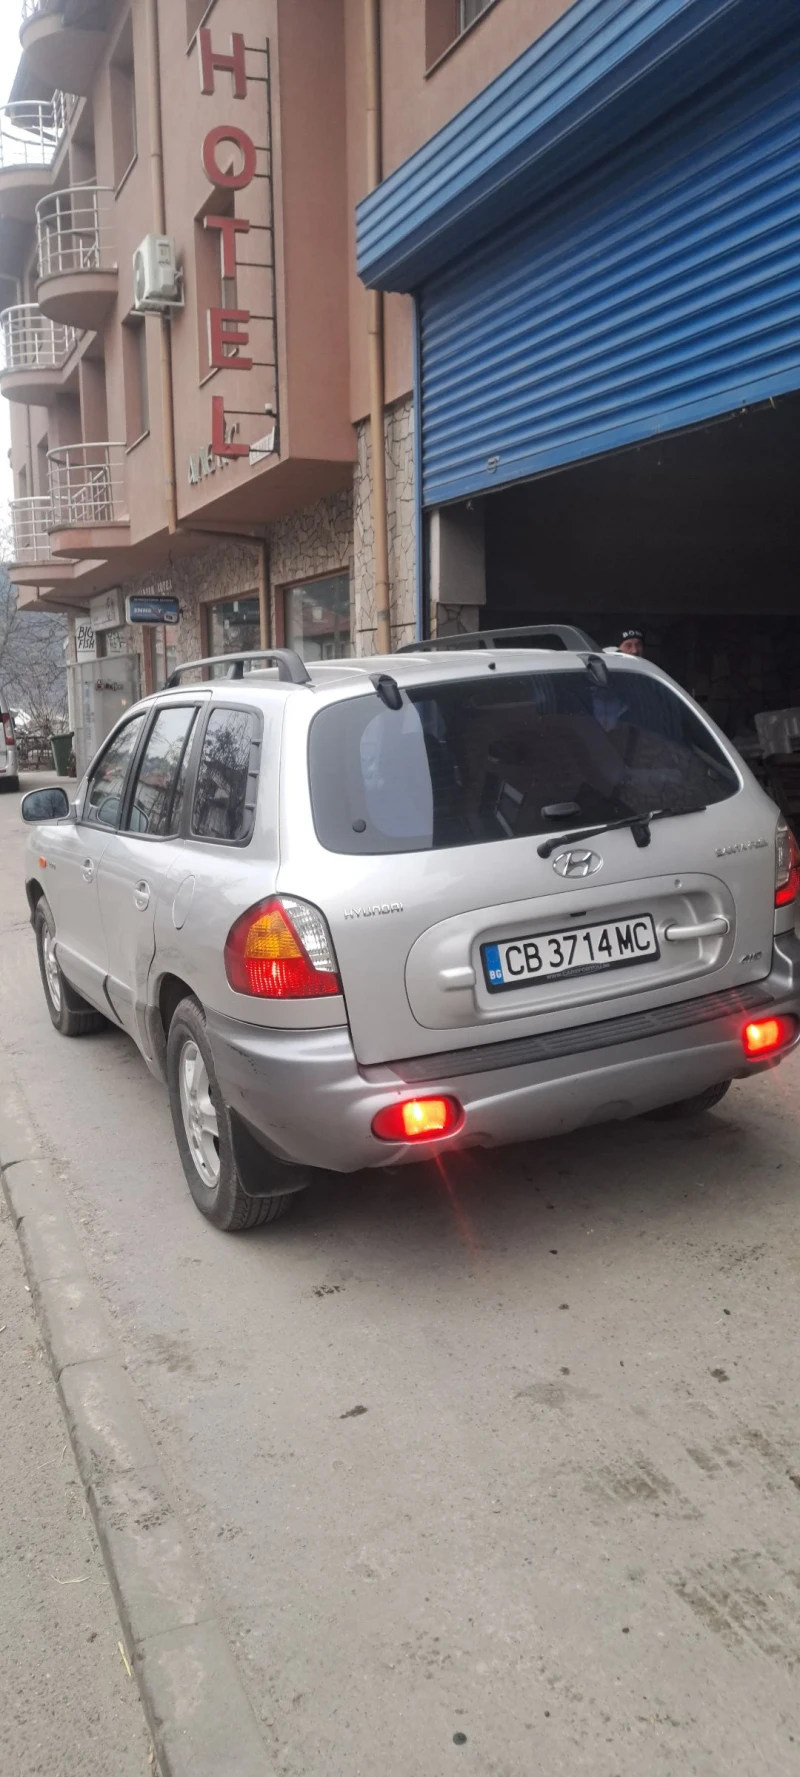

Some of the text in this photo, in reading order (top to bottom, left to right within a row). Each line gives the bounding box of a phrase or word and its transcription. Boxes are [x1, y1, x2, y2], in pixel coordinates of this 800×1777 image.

[199, 28, 257, 458] HOTEL
[78, 626, 94, 640] BIG
[78, 639, 95, 649] FISH
[343, 901, 404, 920] HYUNDAI
[505, 922, 651, 976] CB 3714 MC
[489, 969, 503, 980] BG
